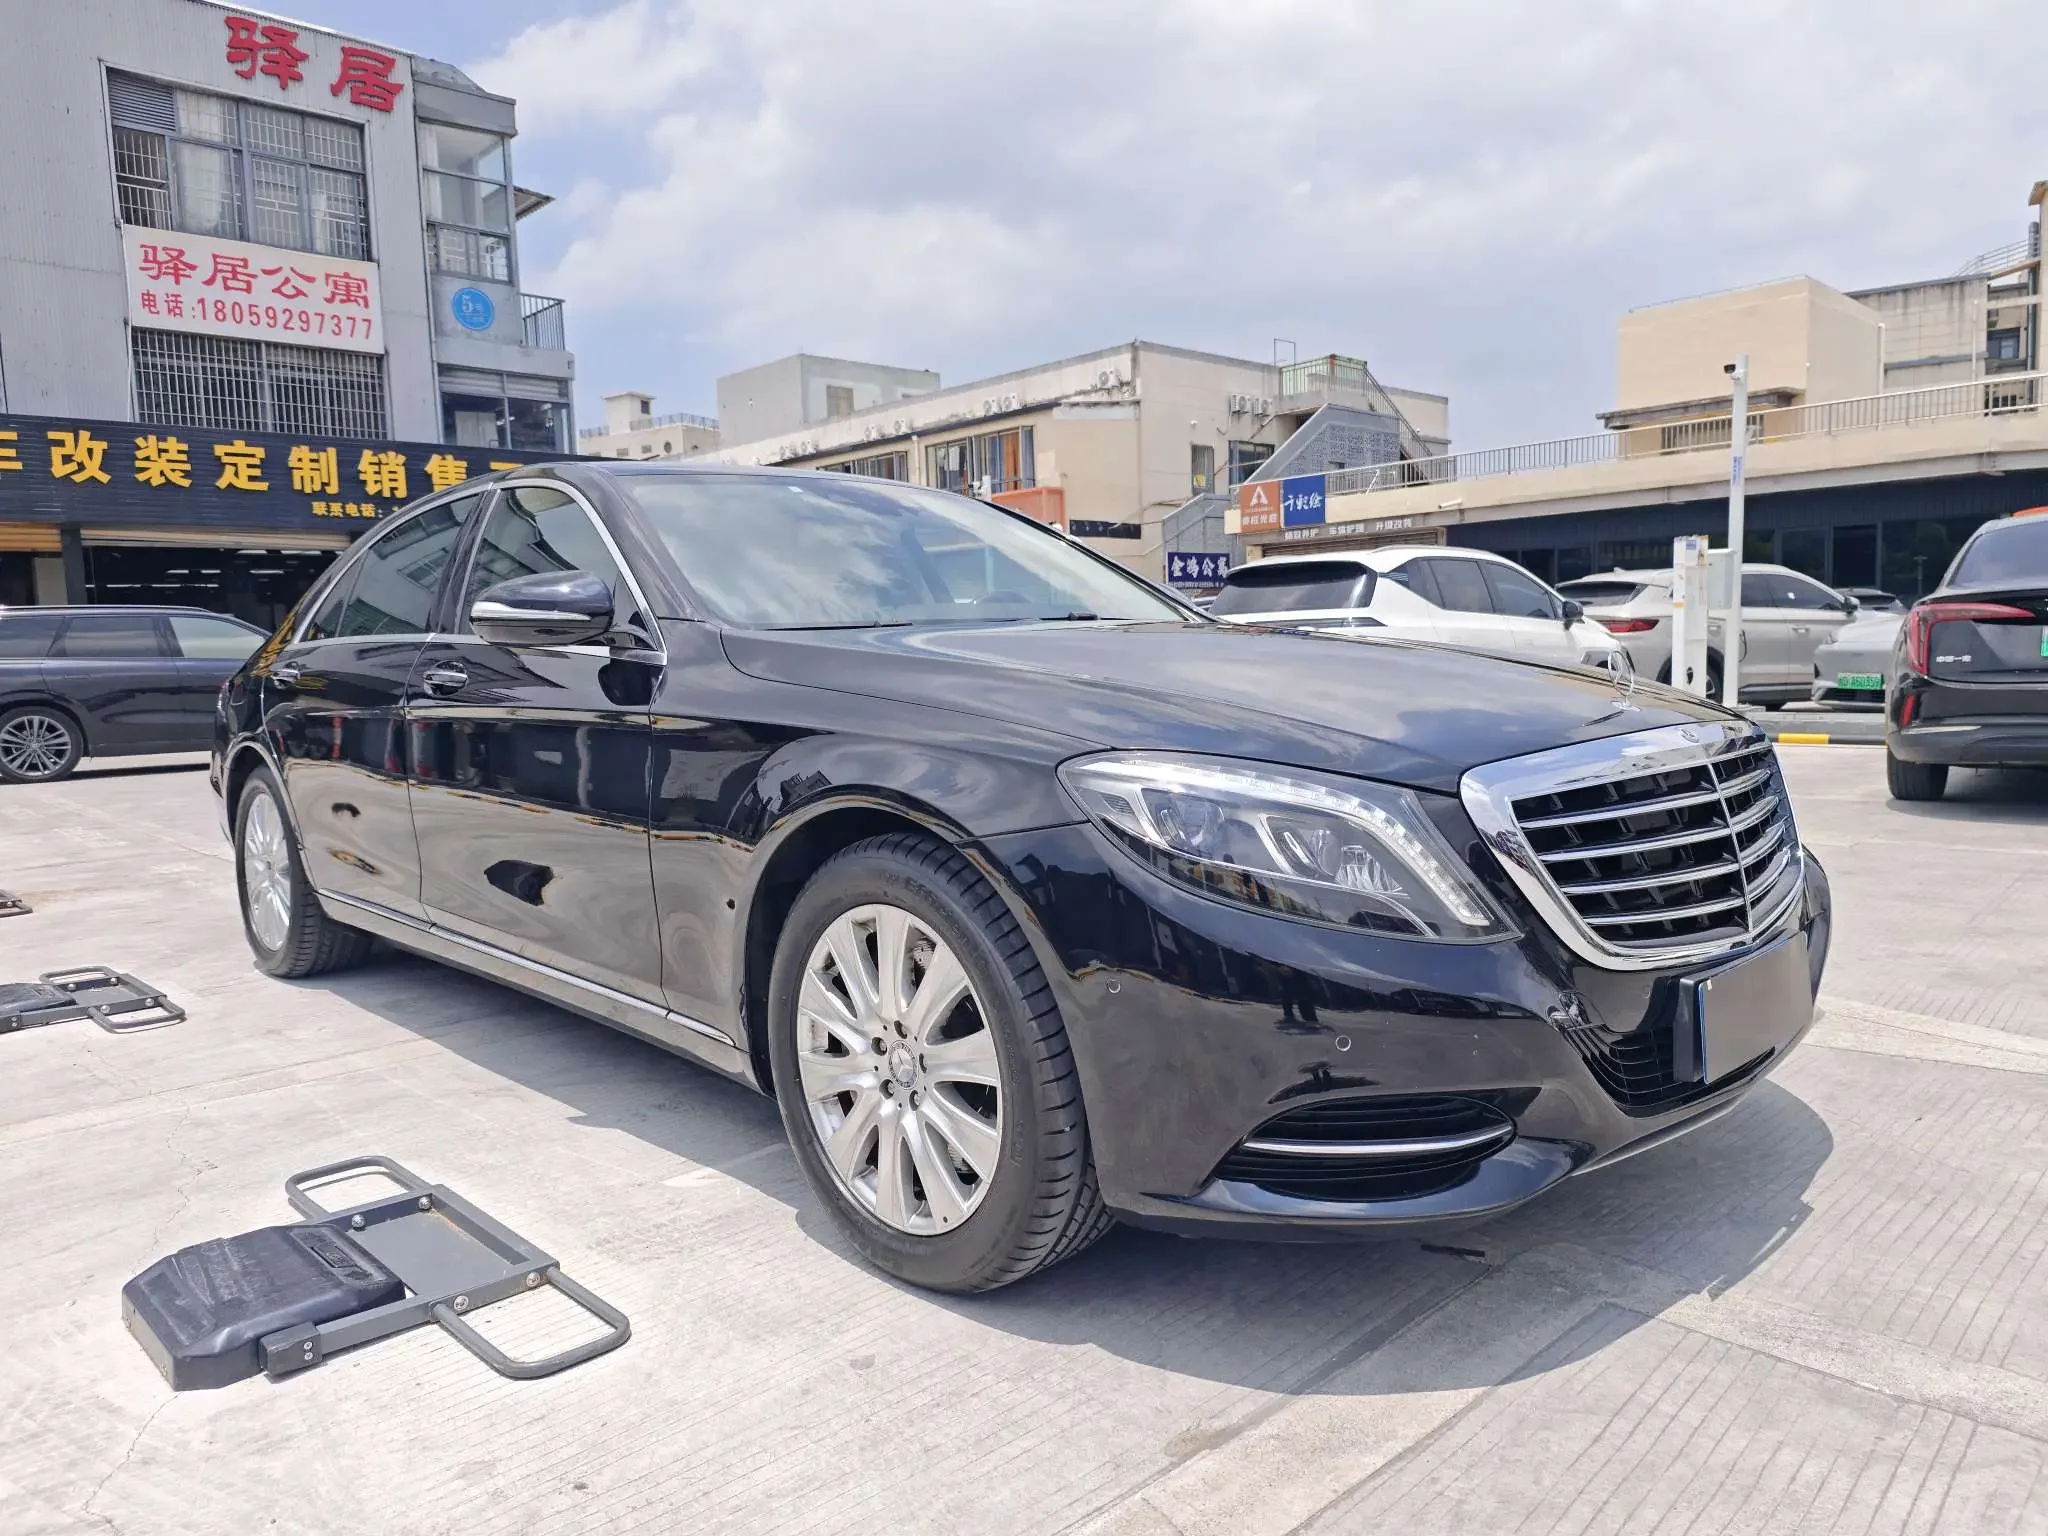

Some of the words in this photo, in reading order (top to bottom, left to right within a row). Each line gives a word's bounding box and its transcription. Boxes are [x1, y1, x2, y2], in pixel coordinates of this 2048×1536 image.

[224, 16, 405, 113] 驿居
[139, 244, 370, 309] 驿居公寓
[141, 289, 373, 340] 电话:18059297377
[0, 430, 525, 498] 改装定制销售
